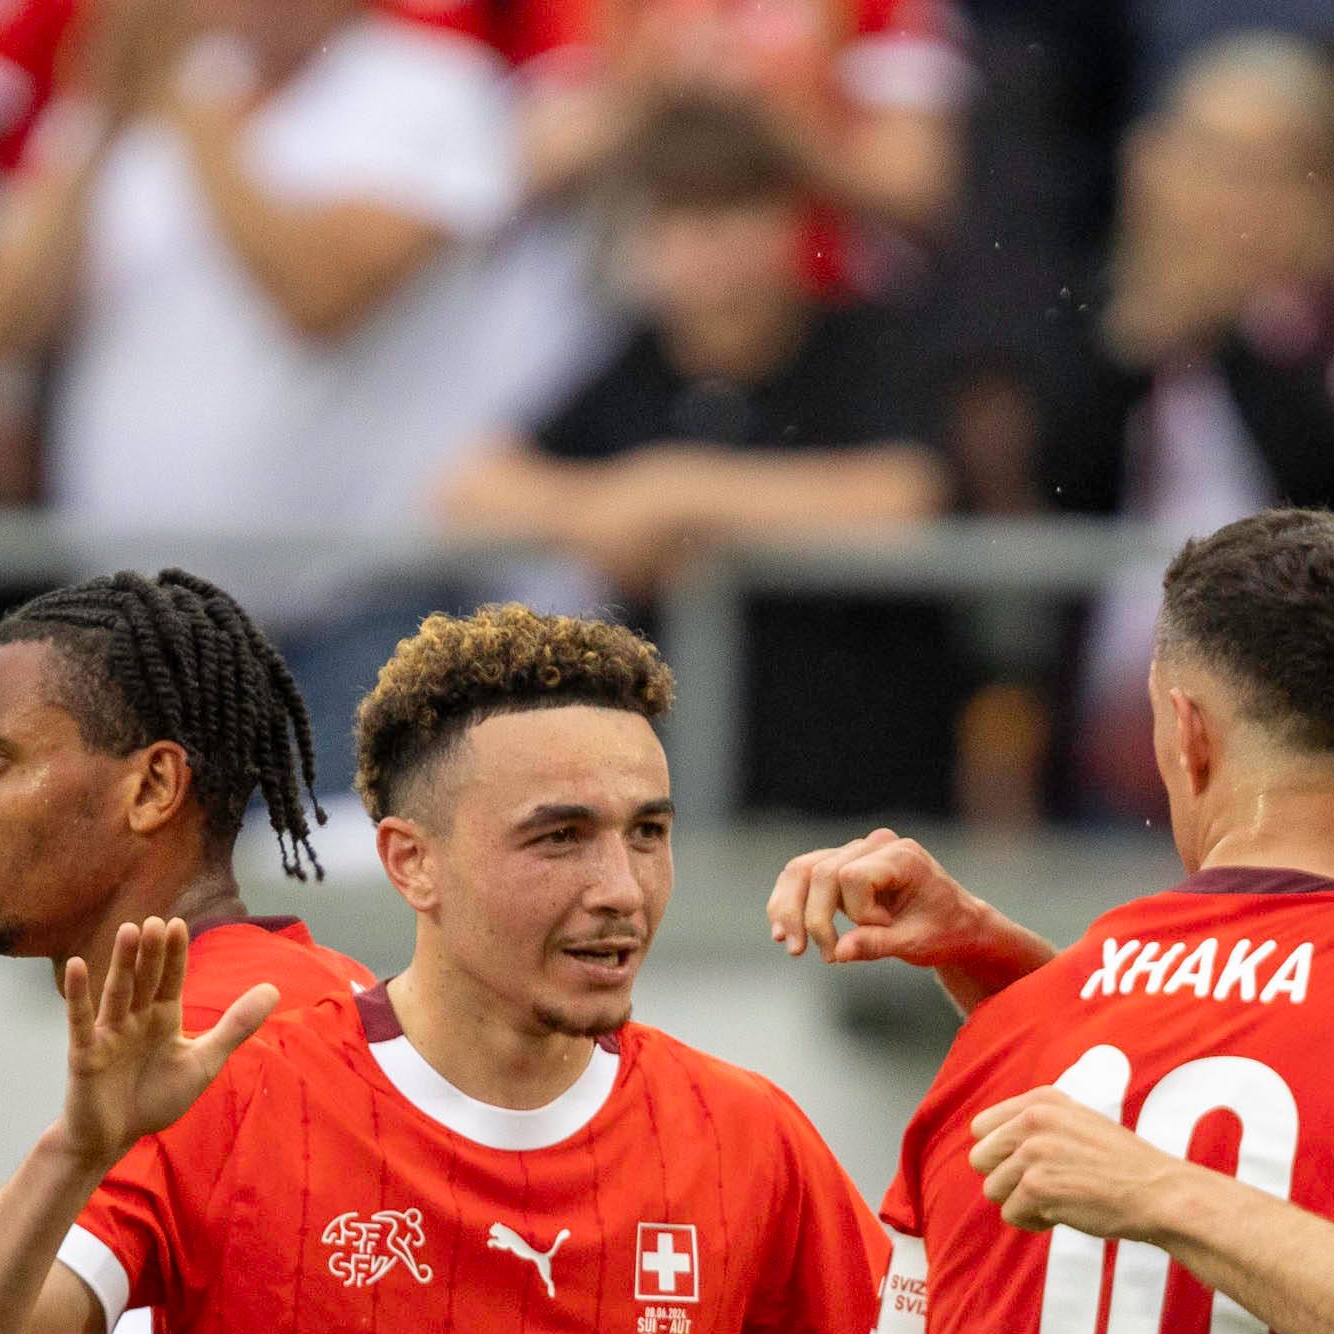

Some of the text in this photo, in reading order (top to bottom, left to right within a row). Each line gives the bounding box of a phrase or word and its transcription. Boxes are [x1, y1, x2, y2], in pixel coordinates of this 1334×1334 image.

[1079, 937, 1315, 1005] XHAKA
[895, 1294, 926, 1316] SVI
[637, 1317, 657, 1334] SUI
[670, 1319, 692, 1334] AUT
